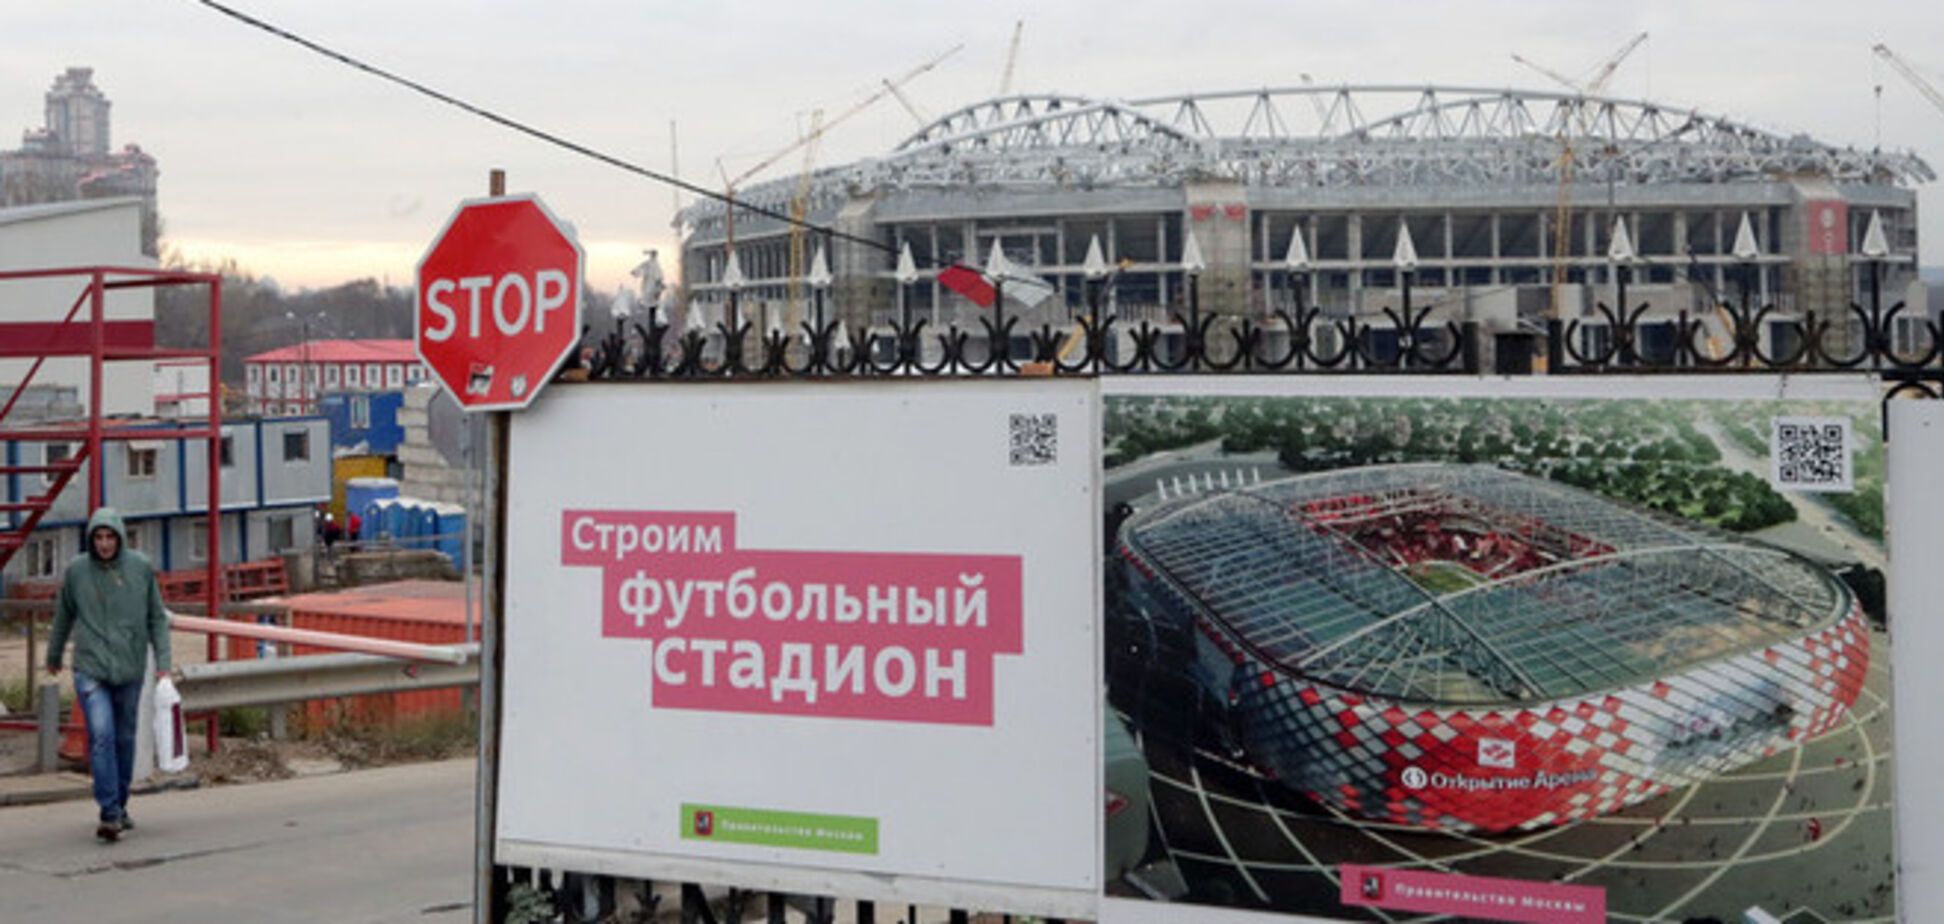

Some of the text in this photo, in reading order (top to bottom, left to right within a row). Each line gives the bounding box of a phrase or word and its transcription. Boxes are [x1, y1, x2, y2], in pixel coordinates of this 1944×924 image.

[424, 269, 570, 342] STOP
[571, 516, 722, 560] Строим
[618, 567, 988, 628] футбольный
[653, 635, 967, 704] стадион
[1431, 772, 1529, 791] Открытие
